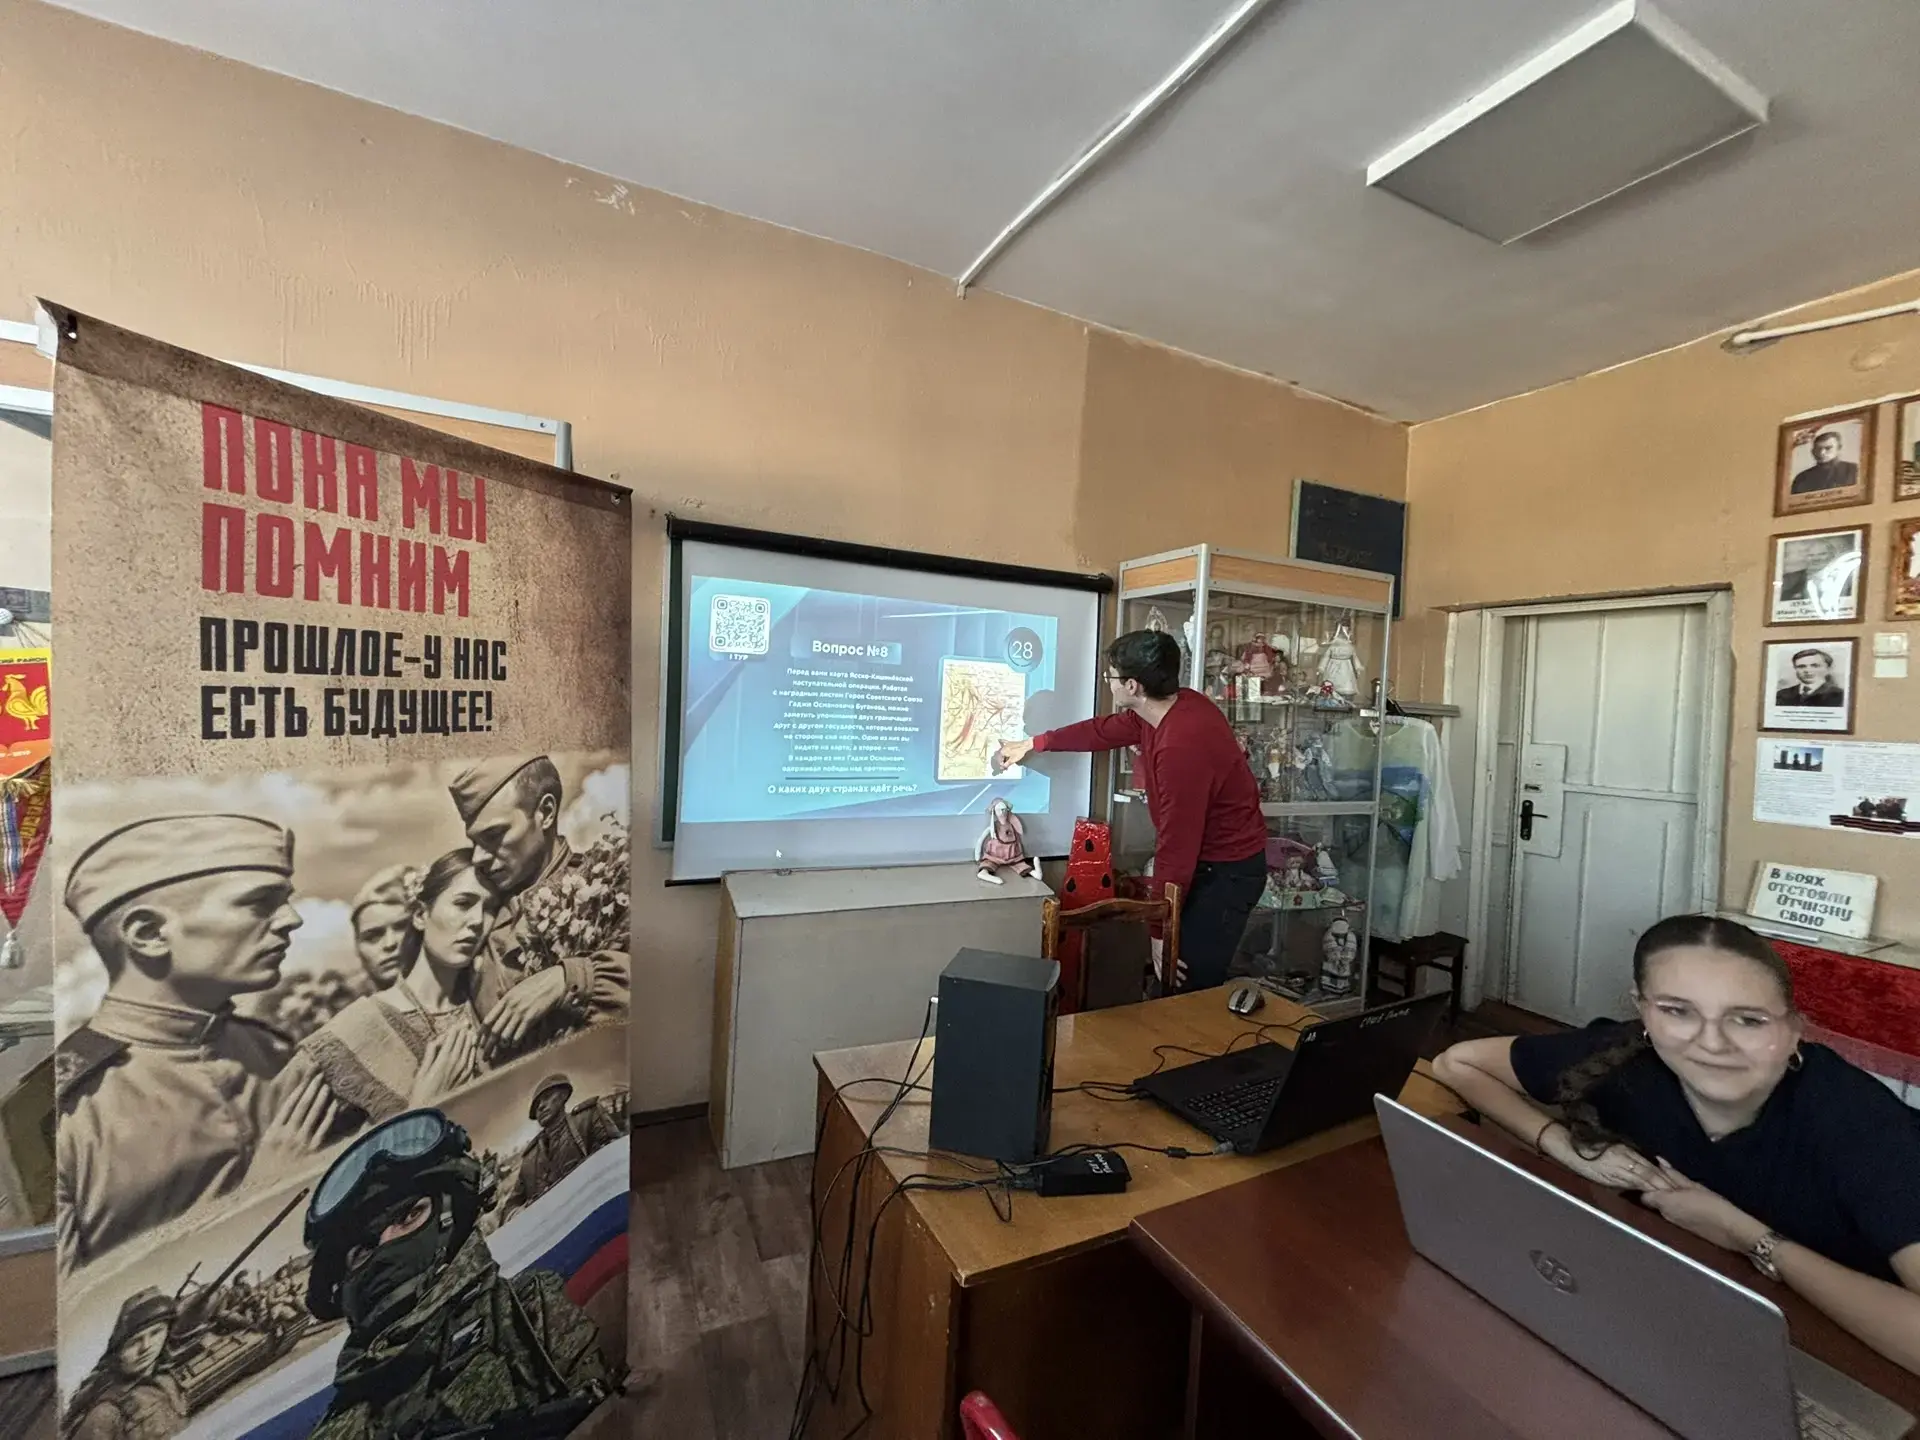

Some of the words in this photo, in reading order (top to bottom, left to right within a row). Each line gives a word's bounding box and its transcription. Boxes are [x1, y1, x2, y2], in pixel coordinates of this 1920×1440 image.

[202, 402, 378, 521] ПОКА
[402, 460, 486, 543] МЫ
[202, 502, 470, 617] ПОМНИМ
[200, 616, 441, 679] ПРОШЛОЕ-У
[454, 636, 507, 681] НАС
[812, 639, 864, 658] Вопрос
[866, 644, 888, 658] №8
[1012, 641, 1033, 659] 28
[201, 686, 307, 740] ЕСТЬ
[324, 687, 493, 738] БУДУЩЕЕ!
[767, 784, 776, 794] О
[778, 786, 807, 794] каких
[808, 785, 830, 794] двух
[832, 785, 868, 794] странах
[870, 783, 891, 793] идёт
[892, 783, 918, 793] речь?
[1770, 868, 1781, 879] В
[1785, 871, 1826, 887] БОЯХ
[1767, 882, 1851, 905] ОТСТОЯЛИ
[1776, 894, 1854, 922] ОТЧИЗНУ
[1780, 908, 1825, 927] СВОЮ
